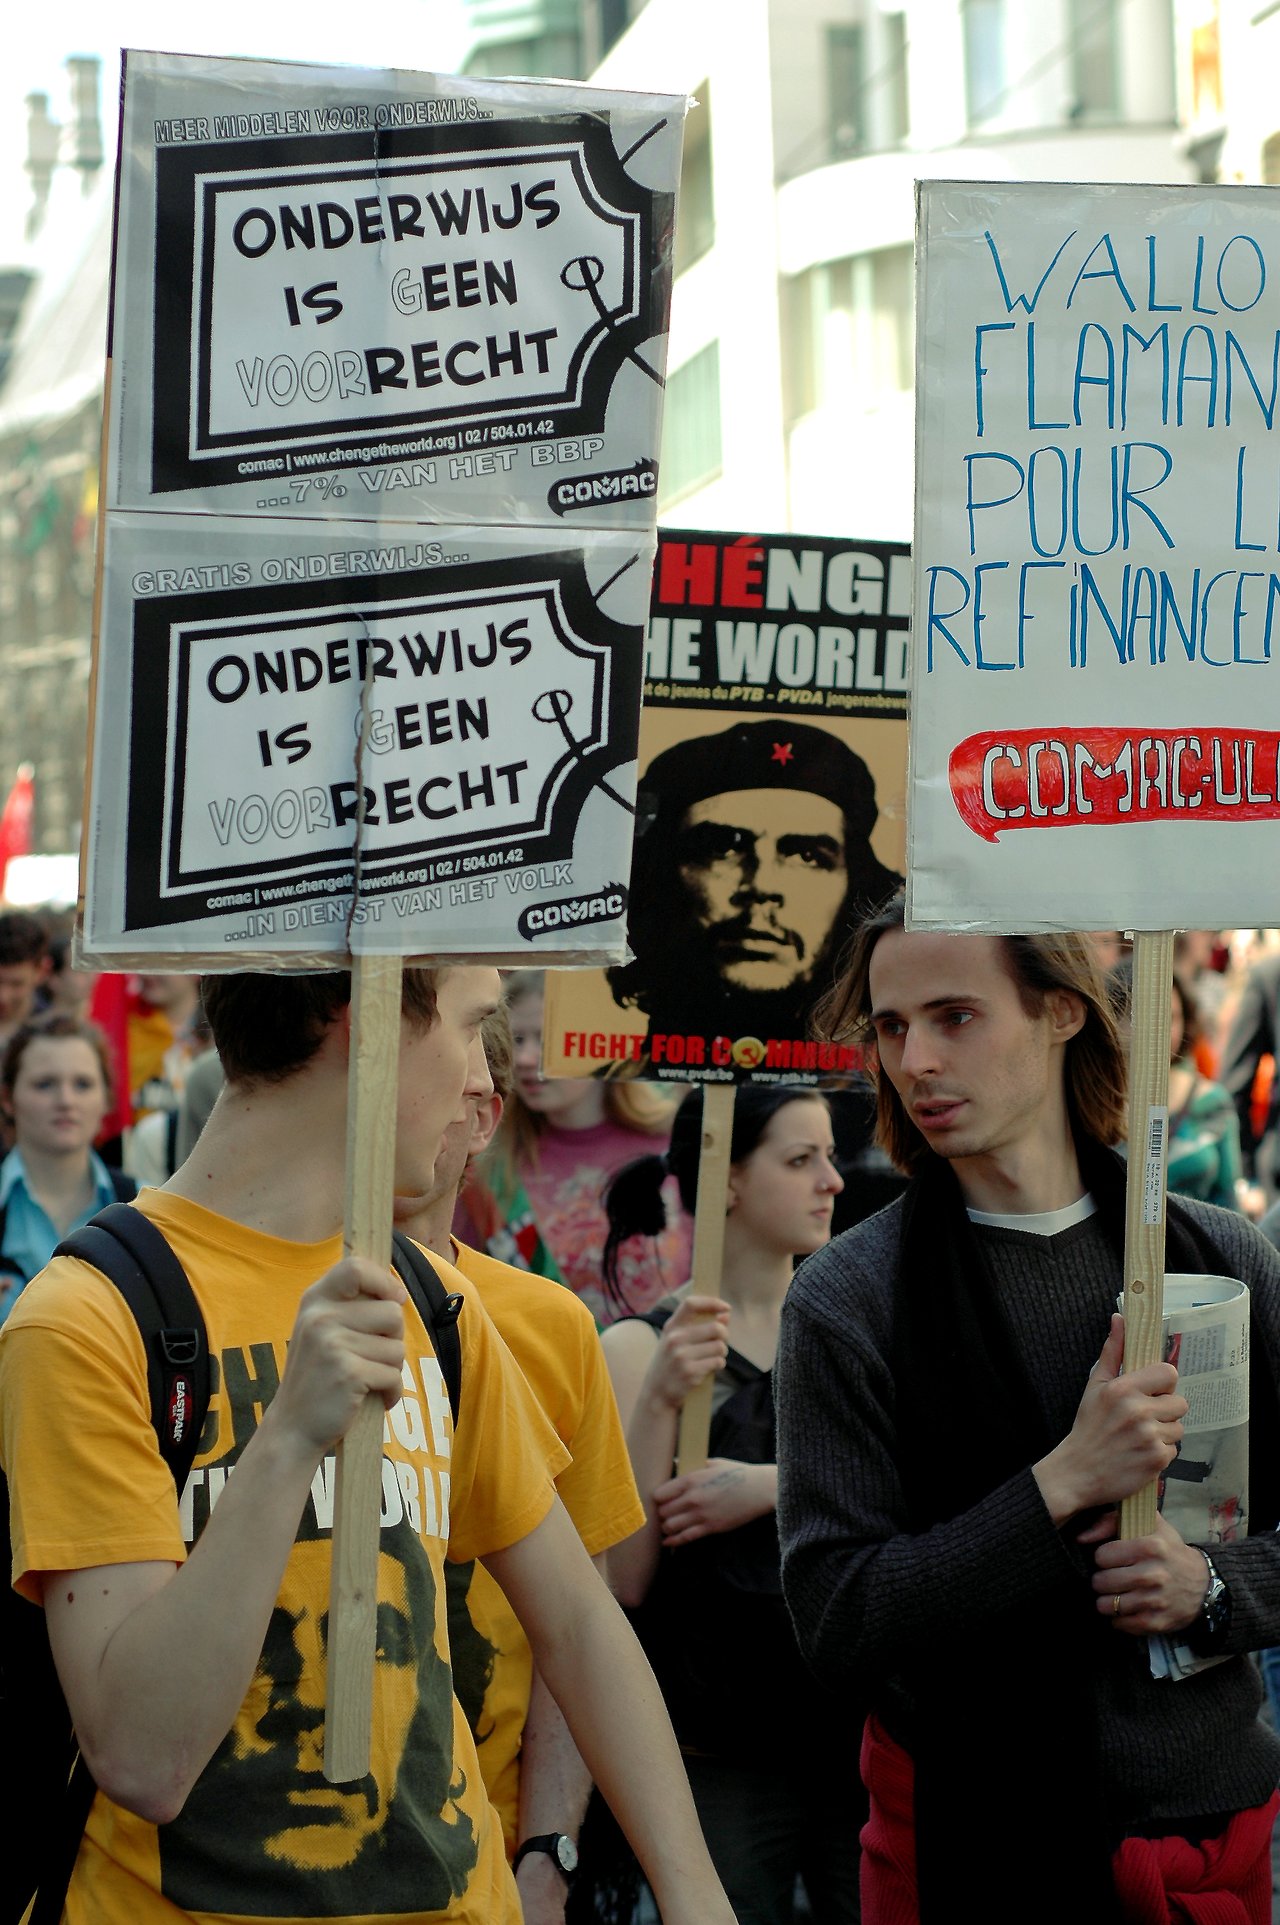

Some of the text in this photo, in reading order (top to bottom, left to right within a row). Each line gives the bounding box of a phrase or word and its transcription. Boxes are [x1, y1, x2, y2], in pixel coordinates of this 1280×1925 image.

[154, 96, 494, 143] MEER MIDDELEN VOOR ONDERWIJS...
[232, 179, 561, 259] ONDERWIJS
[284, 259, 518, 327] IS GEEN
[984, 230, 1267, 315] WALLO
[236, 327, 559, 408] VOORRECHT
[974, 321, 1280, 438] FLAMAN
[237, 458, 285, 475] comac
[465, 429, 483, 444] 02
[490, 419, 555, 441] 504.01.42
[358, 462, 436, 494] VAN
[449, 448, 519, 480] HET
[530, 437, 605, 468] BBP
[557, 470, 656, 506] COMAC
[963, 442, 1280, 558] POUR L
[131, 542, 470, 595] GRATIS ONDERWIJS...
[652, 536, 911, 617] HÉNG
[206, 618, 532, 704] ONDERWIJS
[645, 617, 702, 682] HE
[654, 683, 671, 697] de
[729, 686, 764, 702] PTB
[777, 688, 824, 706] PVDA
[258, 697, 490, 768] IS GEEN
[207, 760, 529, 846] VOORRECHT
[981, 736, 1280, 820] COMAC-UL
[207, 892, 253, 909] comac
[436, 862, 454, 877] 02
[463, 848, 524, 872] 504.01.42
[283, 898, 385, 931] DIENST
[395, 889, 445, 918] VAN
[449, 876, 498, 907] HET
[503, 863, 575, 895] VOLK
[527, 893, 623, 931] COMAC
[563, 1031, 647, 1063] FIGHT
[651, 1034, 705, 1065] FOR
[173, 1381, 186, 1439] EASTPAK
